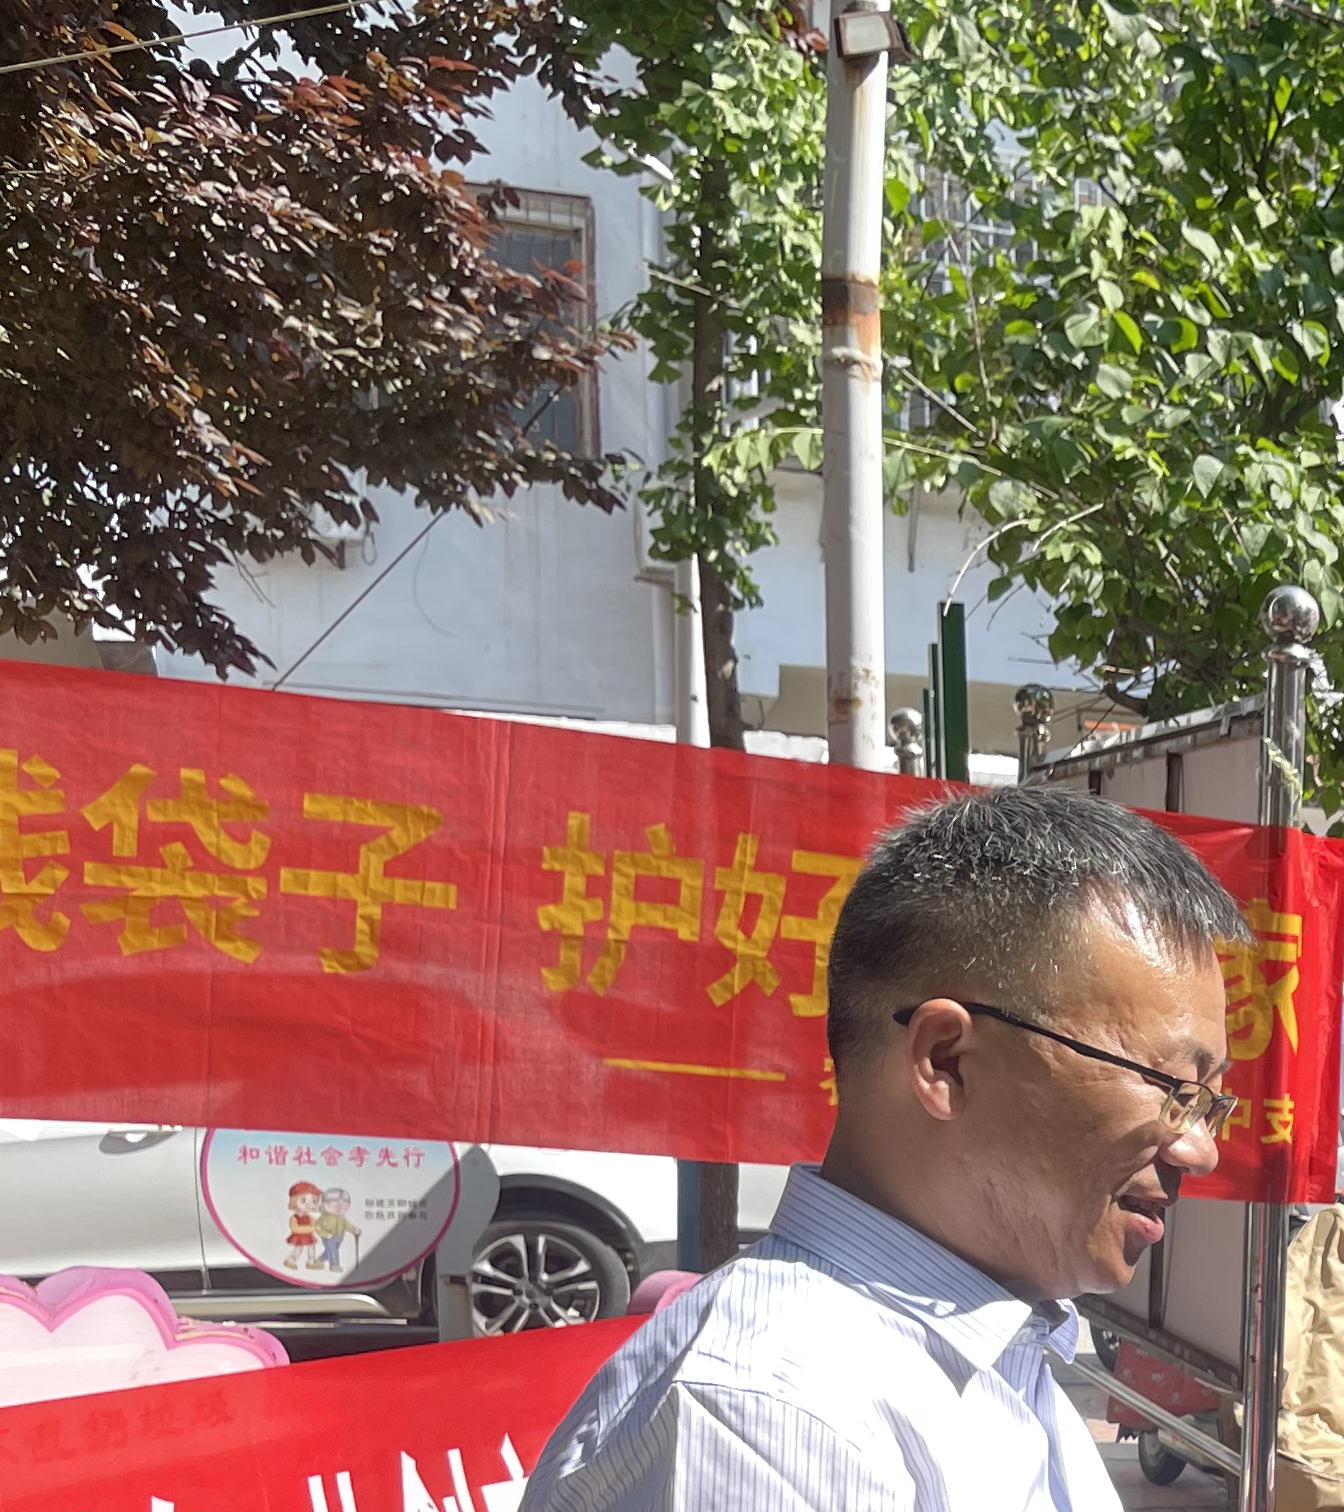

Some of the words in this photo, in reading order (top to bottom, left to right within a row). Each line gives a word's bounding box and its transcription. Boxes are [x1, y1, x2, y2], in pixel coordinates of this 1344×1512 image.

[236, 1143, 426, 1168] 和谐社会孝先行
